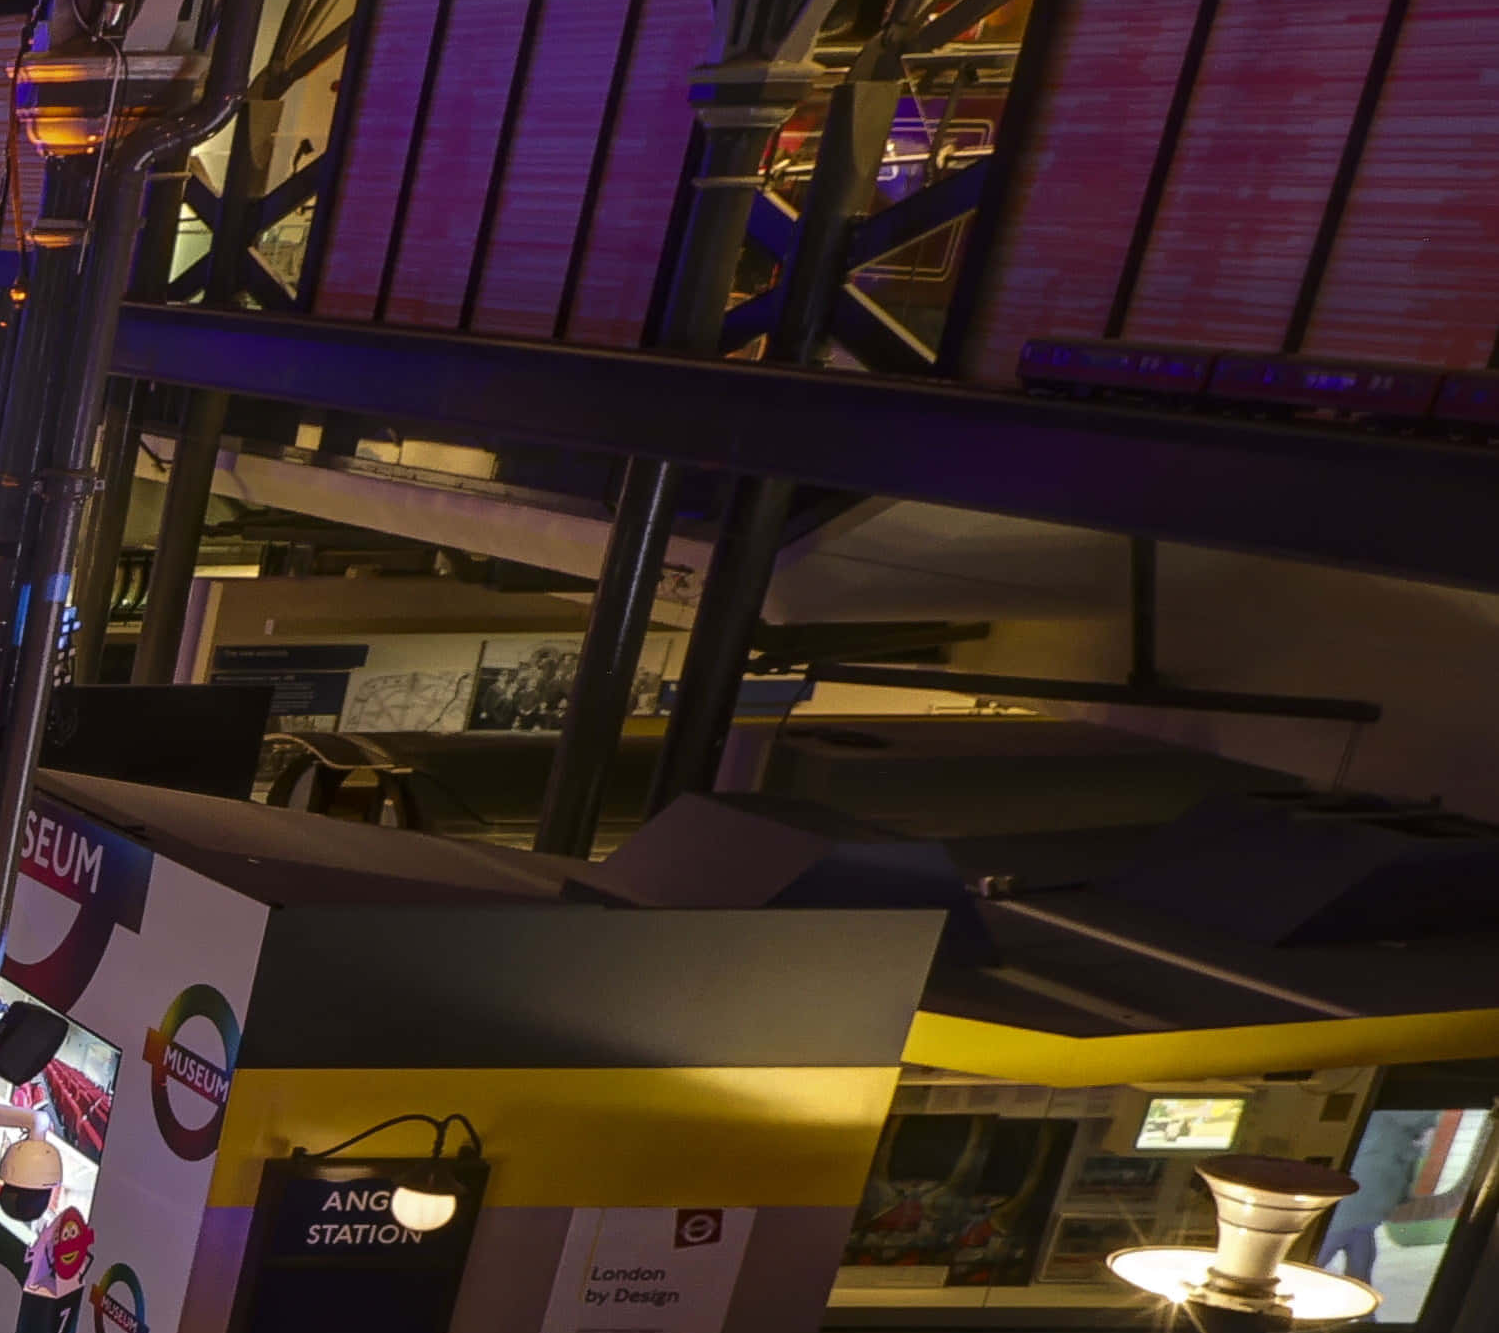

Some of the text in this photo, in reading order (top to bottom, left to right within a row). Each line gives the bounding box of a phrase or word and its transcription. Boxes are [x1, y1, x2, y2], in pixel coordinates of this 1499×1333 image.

[20, 809, 104, 895] SEUM
[162, 1045, 230, 1103] MUSEUM
[322, 1190, 391, 1213] ANG
[306, 1223, 423, 1245] STATION
[590, 1266, 667, 1282] London
[584, 1287, 681, 1307] by Design
